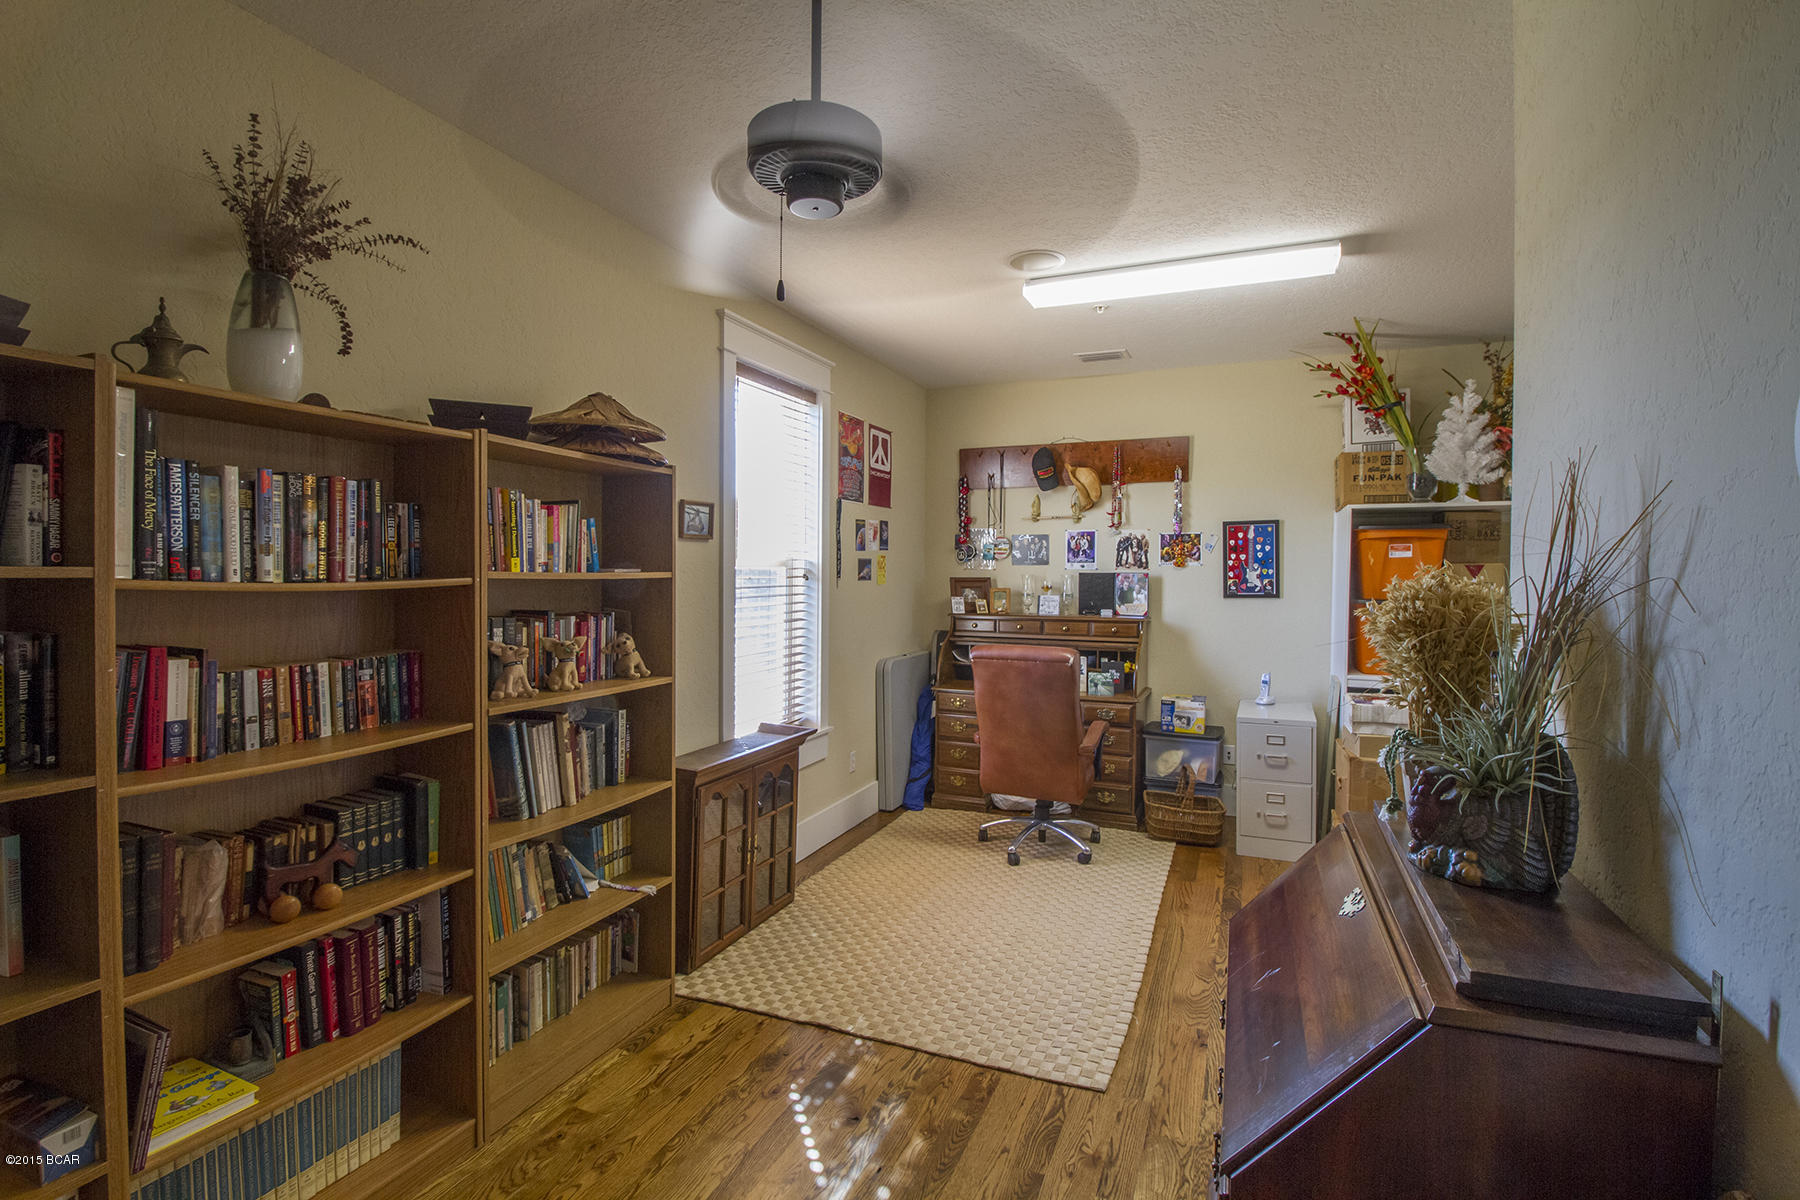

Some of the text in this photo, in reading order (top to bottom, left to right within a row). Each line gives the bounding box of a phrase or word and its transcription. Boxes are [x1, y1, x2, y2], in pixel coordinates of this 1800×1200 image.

[141, 449, 157, 530] The Face of Mercy
[189, 472, 201, 521] SILENCER
[288, 475, 297, 498] HOAG
[1353, 472, 1402, 483] FUN-PAK
[49, 498, 61, 549] SAMMY HAGAR
[168, 463, 184, 552] JAMES PATTERSON
[318, 520, 328, 580] STUART WOODS
[19, 670, 32, 701] allman
[124, 656, 142, 745] Treasure Coast GOLD
[408, 913, 417, 967] STUART WOODS
[305, 951, 315, 973] Private
[286, 986, 294, 998] LEE
[308, 972, 318, 994] Games
[169, 1070, 222, 1094] George
